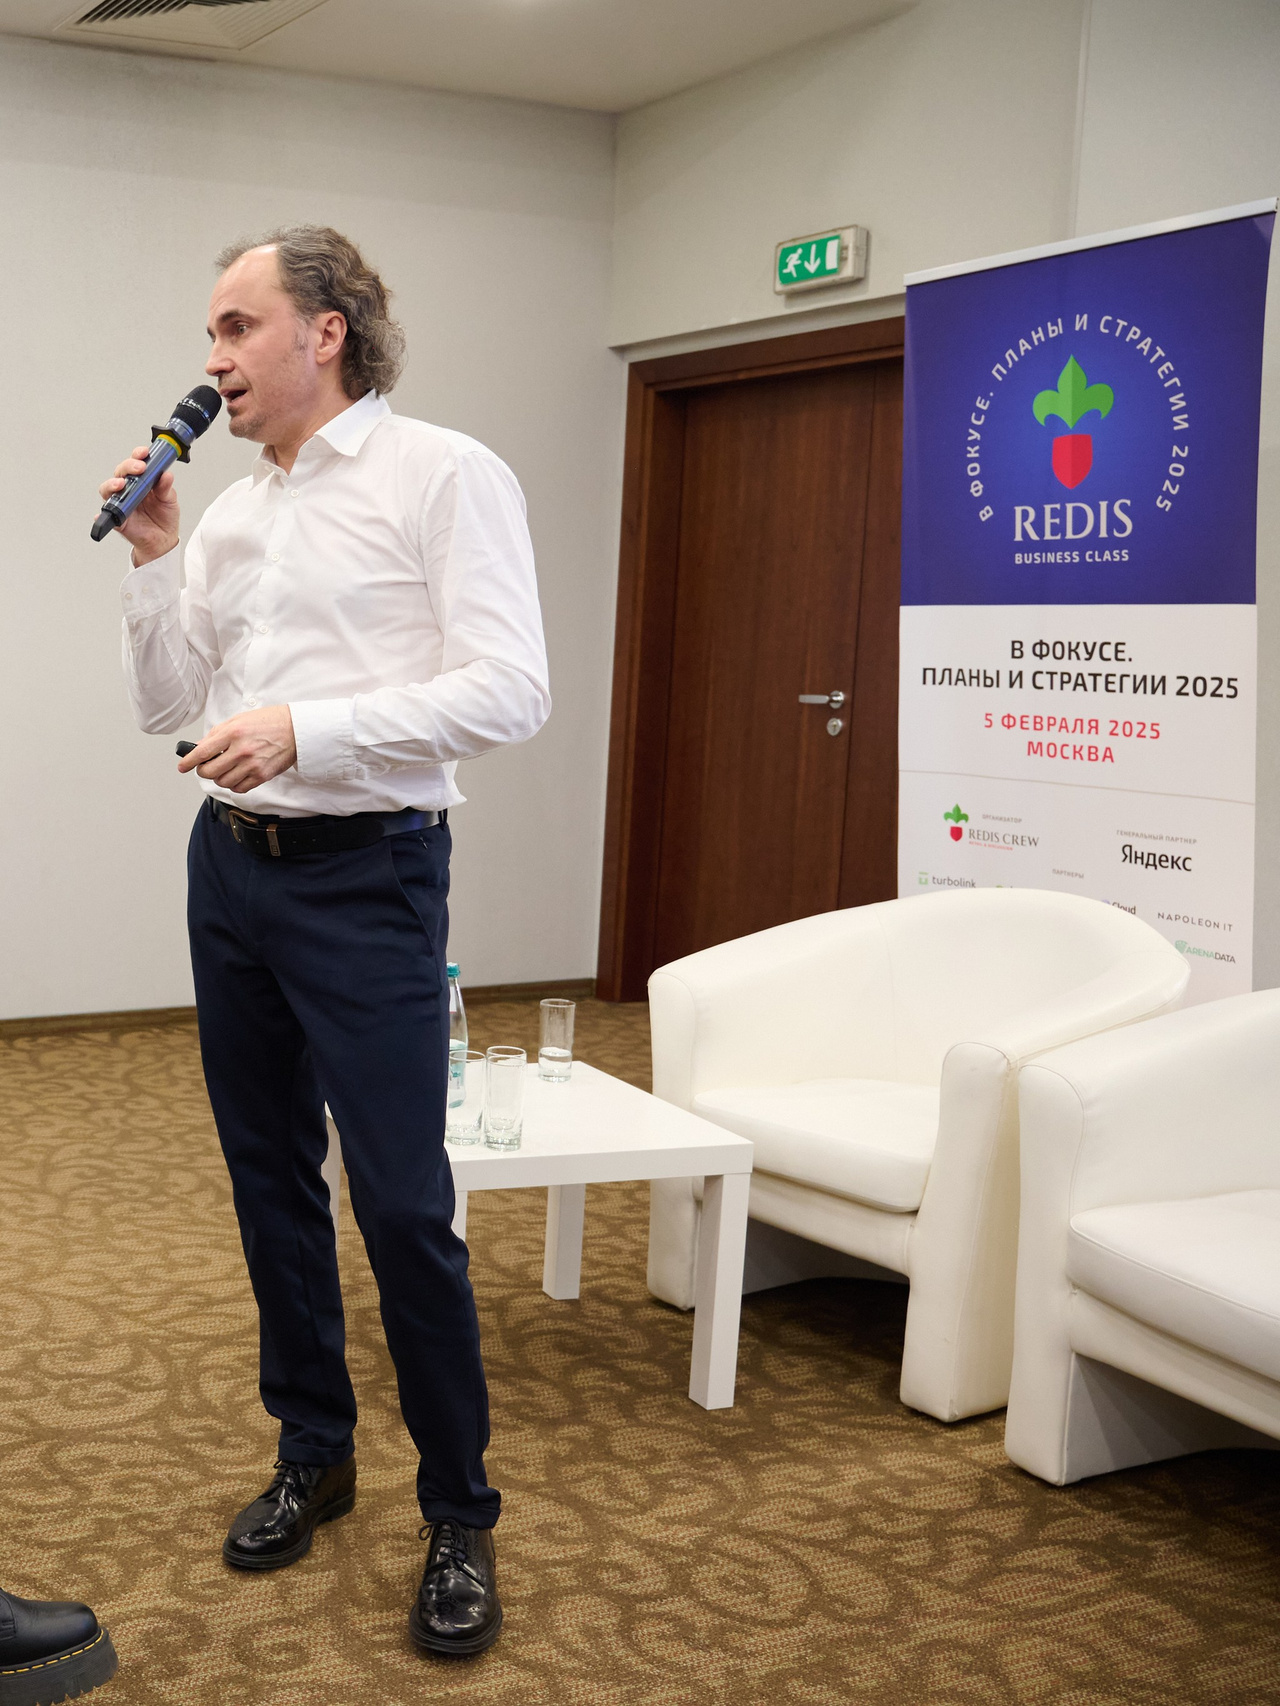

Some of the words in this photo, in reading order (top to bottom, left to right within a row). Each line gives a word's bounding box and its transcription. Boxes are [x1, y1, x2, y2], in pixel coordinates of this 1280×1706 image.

[1074, 313, 1088, 331] И
[991, 317, 1063, 382] ПЛАНЫ
[1099, 315, 1190, 431] СТРАТЕГИИ
[966, 391, 994, 498] ФОКУСЕ.
[1155, 445, 1189, 512] 2025
[978, 505, 994, 522] В
[1013, 498, 1133, 542] REDIS
[1014, 550, 1080, 565] BUSINESS
[1085, 549, 1130, 563] CLASS
[1010, 639, 1025, 660] В
[1031, 639, 1133, 663] ФОКУСЕ.
[922, 667, 1000, 689] ПЛАНЫ
[1008, 669, 1024, 689] И
[1031, 670, 1167, 696] СТРАТЕГИИ
[1175, 675, 1239, 700] 2025
[984, 712, 994, 729] 5
[1000, 713, 1099, 736] ФЕВРАЛЯ
[1108, 719, 1161, 740] 2025
[1026, 740, 1115, 764] МОСКВА
[968, 828, 1000, 843] REDIS
[1002, 833, 1040, 847] CREW
[1121, 844, 1192, 872] Яндекс
[931, 876, 977, 889] turbolink
[1157, 911, 1220, 930] NAPOLEON
[1223, 923, 1234, 933] IT
[1186, 945, 1237, 964] ARENADATA
